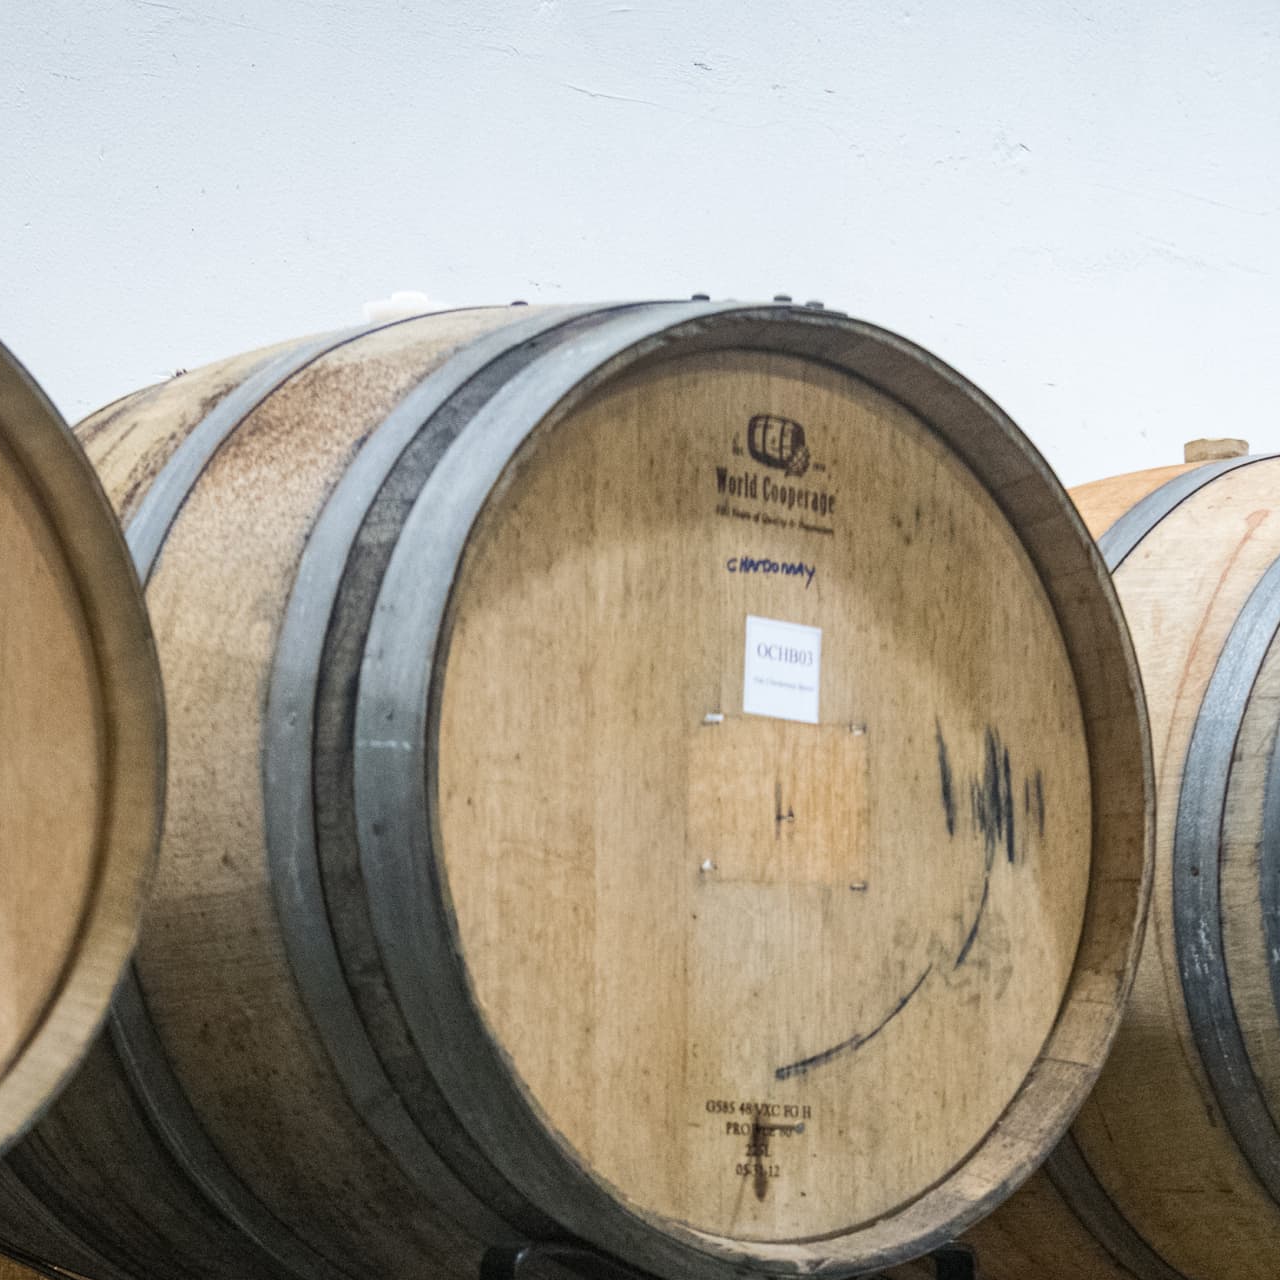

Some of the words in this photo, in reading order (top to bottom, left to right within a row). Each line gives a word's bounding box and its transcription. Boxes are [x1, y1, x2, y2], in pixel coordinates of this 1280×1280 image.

[716, 466, 757, 499] World
[762, 476, 836, 518] Cooperage
[757, 642, 813, 666] OCHB03
